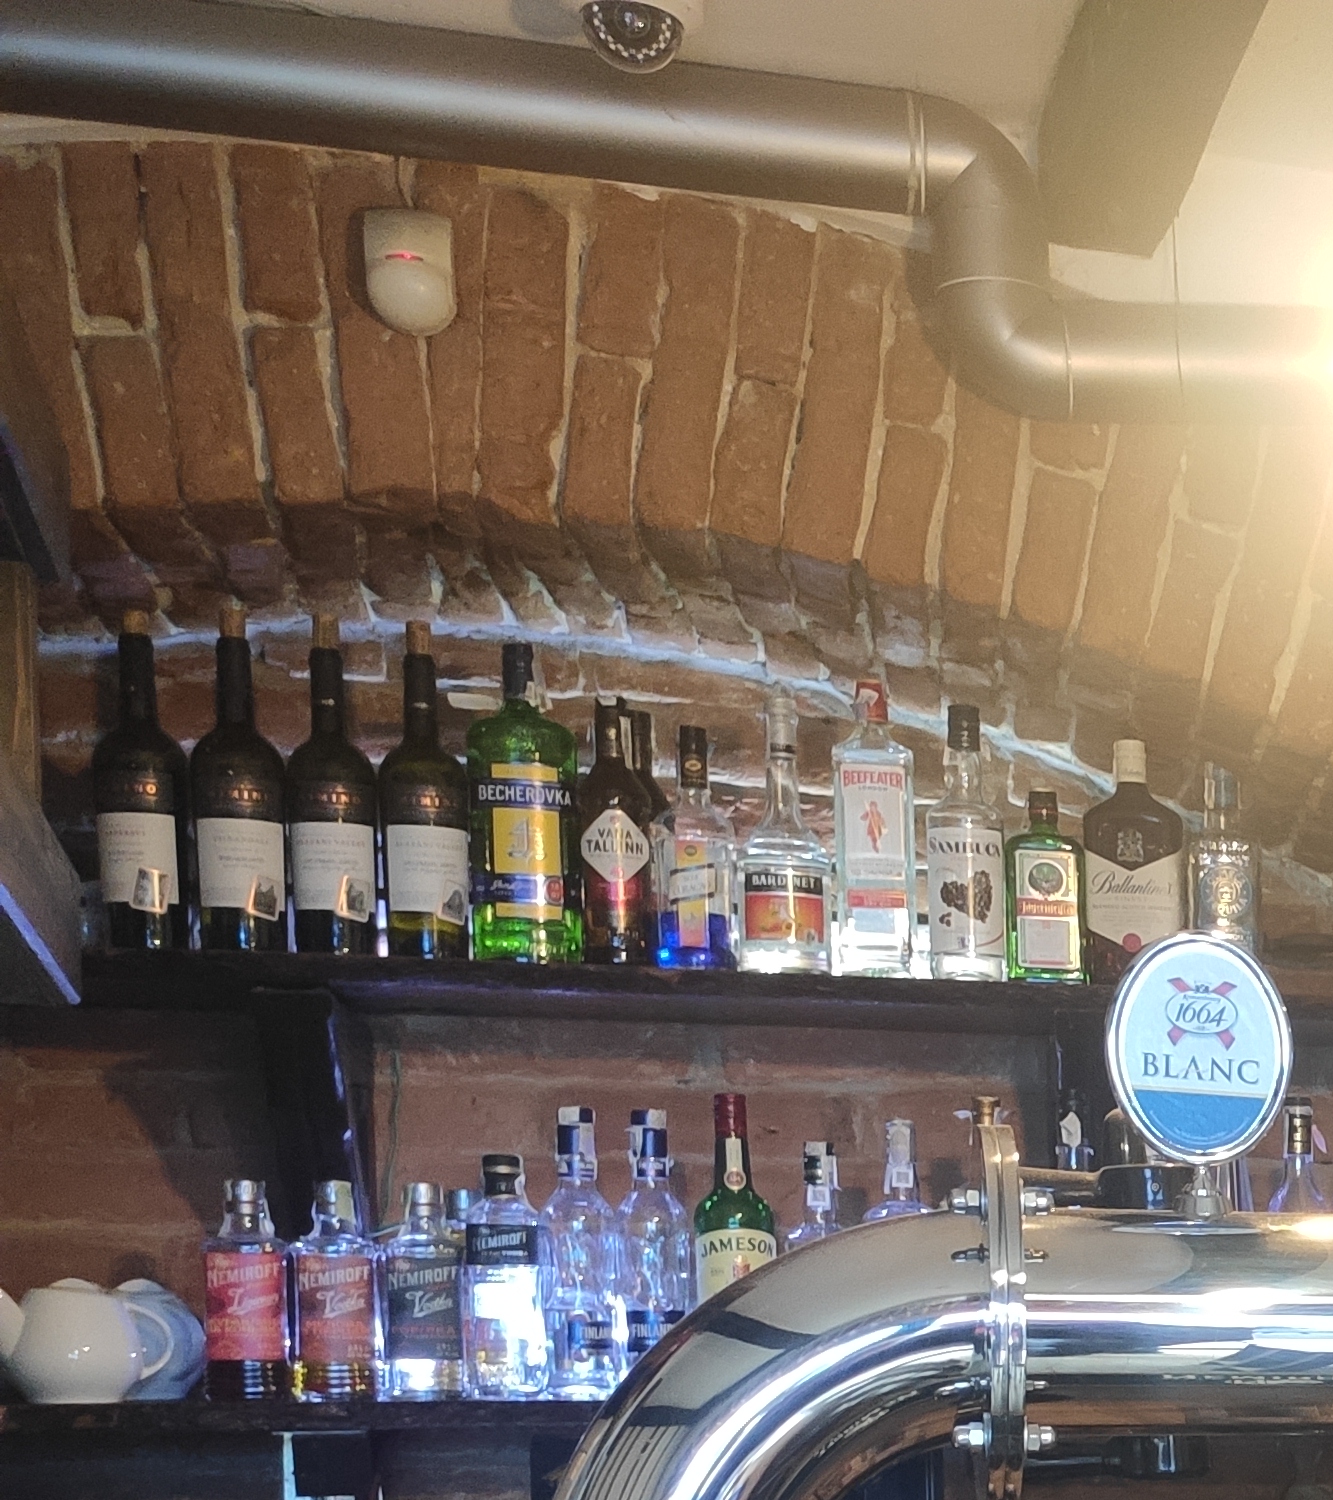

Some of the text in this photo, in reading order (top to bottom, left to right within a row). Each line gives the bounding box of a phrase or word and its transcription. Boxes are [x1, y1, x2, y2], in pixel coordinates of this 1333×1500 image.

[844, 769, 903, 791] BEEFEATER
[478, 783, 572, 807] BECHEROVKA
[597, 827, 633, 841] VANA
[586, 838, 643, 856] TALLINN
[752, 874, 816, 890] BARDNET
[1175, 1000, 1229, 1027] 1664
[1142, 1052, 1260, 1085] BLANC
[701, 1237, 774, 1258] JAMESON
[207, 1264, 280, 1288] NEMIROFF
[299, 1264, 370, 1291] NEMIROFF
[388, 1264, 458, 1291] NEMIROFF
